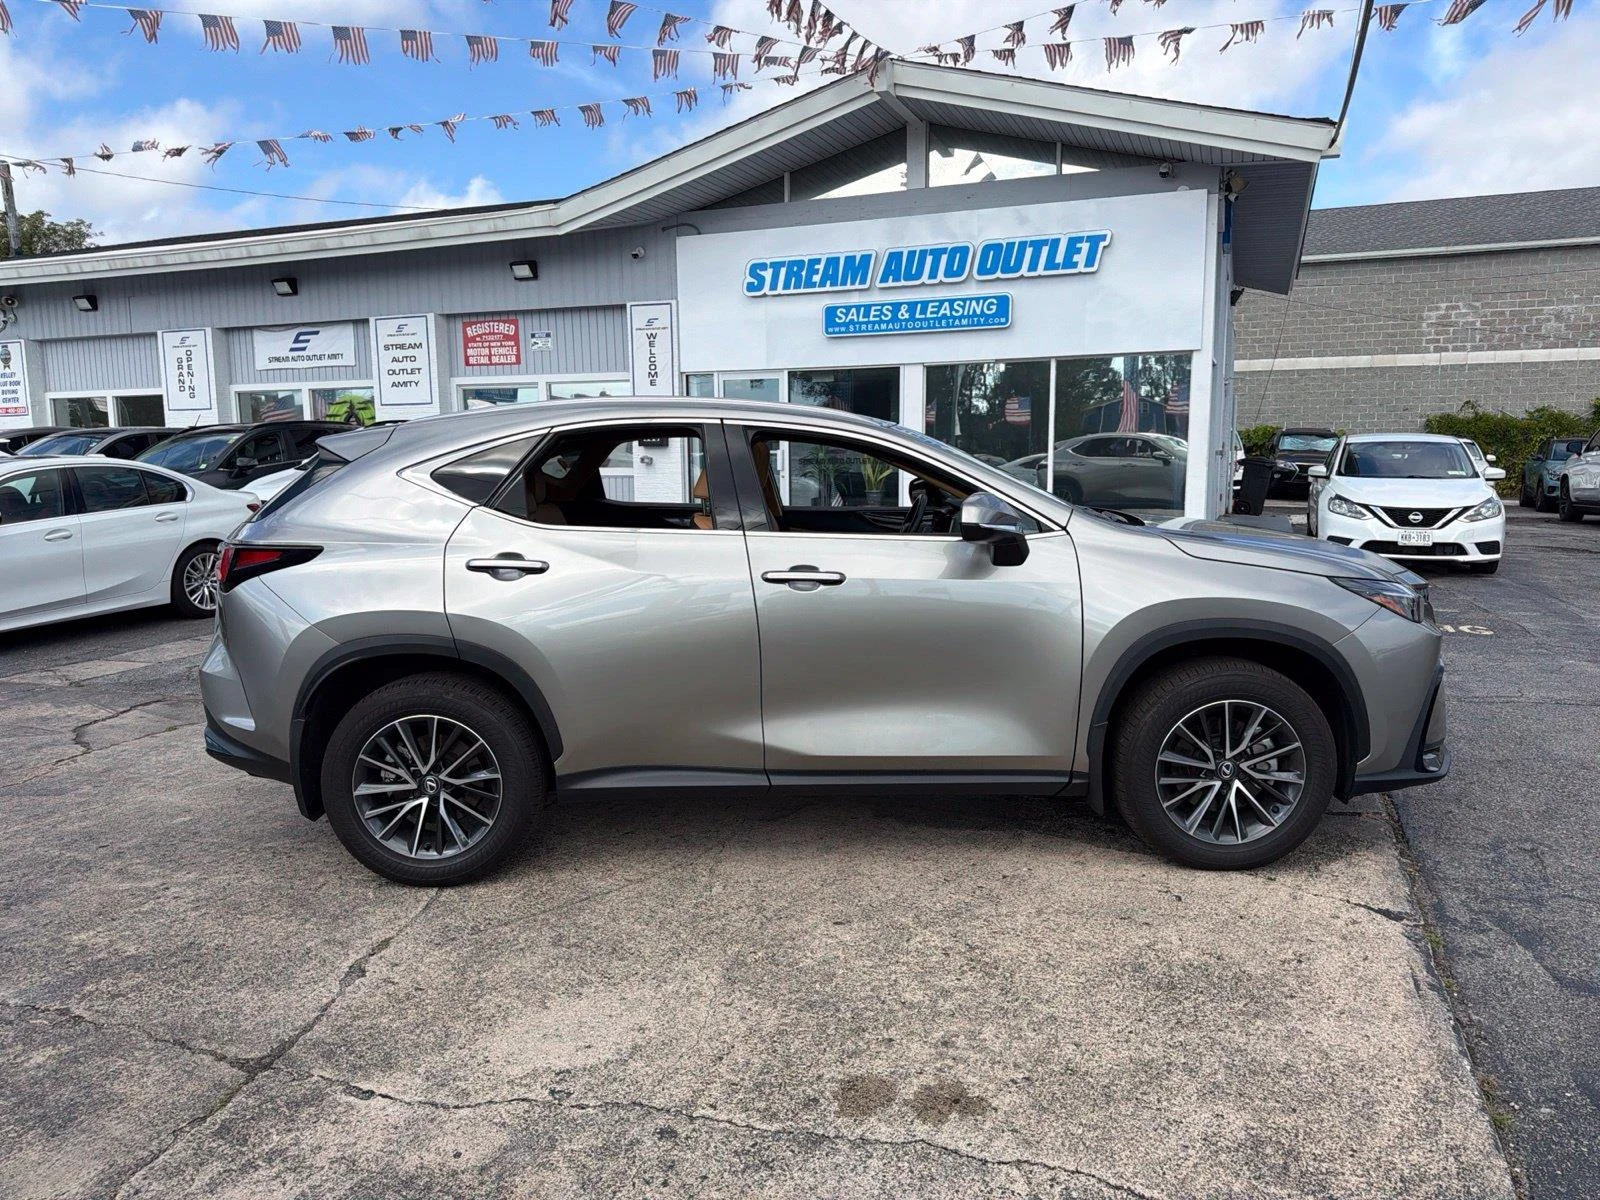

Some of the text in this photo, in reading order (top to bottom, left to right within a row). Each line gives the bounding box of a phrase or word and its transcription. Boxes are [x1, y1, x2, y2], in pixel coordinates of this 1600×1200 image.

[746, 234, 1108, 293] STREAM AUTO OUTLET
[835, 298, 998, 323] SALES & LEASING
[466, 322, 515, 338] REGISTERED
[383, 342, 423, 351] STREAM
[467, 346, 518, 356] MOTOR VEHICLE
[391, 355, 417, 363] AUTO
[469, 355, 516, 364] RETAIL DEALER
[646, 332, 659, 387] WELCOME
[176, 357, 186, 393] GRAND
[185, 349, 196, 399] OPENING
[387, 367, 422, 376] OUTLET
[391, 380, 420, 388] AMITY
[2, 396, 20, 404] CENTER
